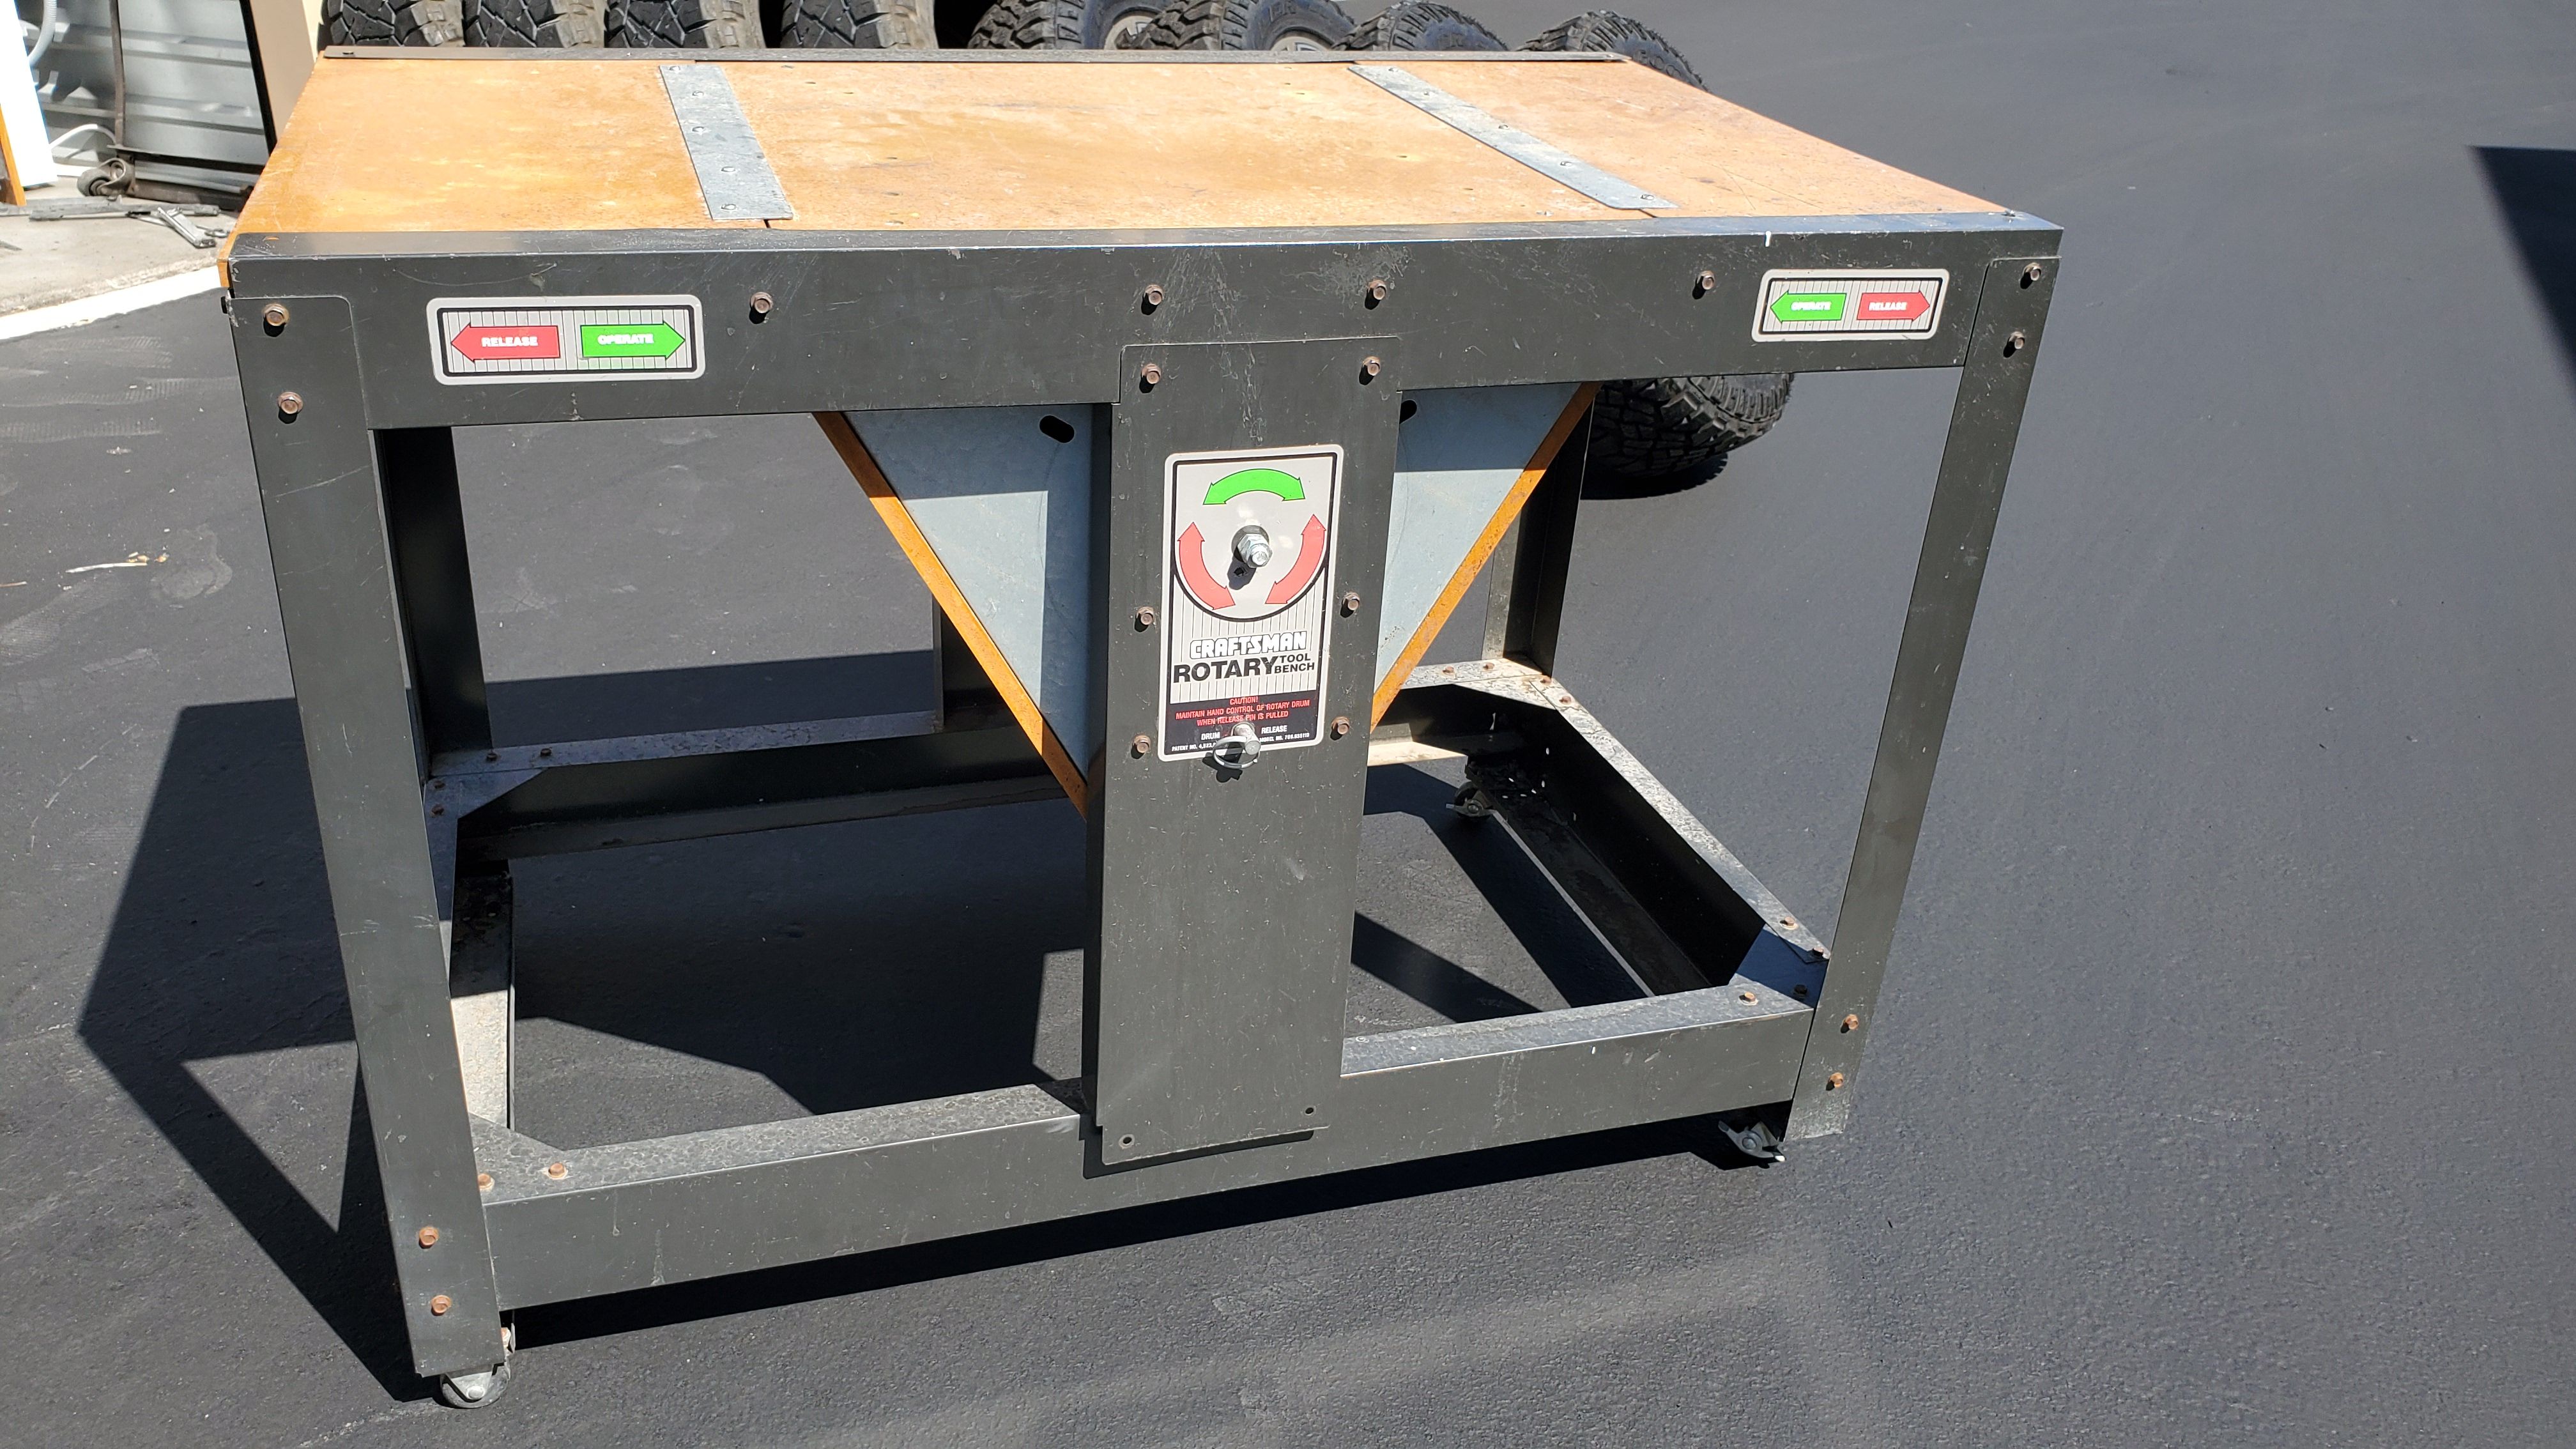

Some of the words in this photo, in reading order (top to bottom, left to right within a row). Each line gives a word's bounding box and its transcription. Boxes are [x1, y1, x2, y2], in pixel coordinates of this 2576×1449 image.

[1791, 302, 1832, 311] OPERATE
[1868, 302, 1908, 311] RELEASE
[481, 336, 539, 348] RELEASE
[597, 334, 655, 345] OPERATE
[1190, 631, 1307, 659] CRAFTSMAN
[1280, 654, 1310, 663] TOOL
[1173, 656, 1278, 683] ROTARY
[1275, 662, 1315, 674] BENCH
[1230, 696, 1258, 705] CAUTION!
[1176, 710, 1205, 719] MAINTAIN
[1226, 705, 1254, 714] CONTROL
[1266, 702, 1290, 710] ROTARY
[1291, 700, 1310, 708] DRUM
[1197, 718, 1216, 726] WHEN
[1217, 714, 1245, 724] RELEASE
[1266, 710, 1289, 719] PULLED
[1201, 732, 1220, 740] DRUM
[1261, 725, 1287, 734] RELEASE
